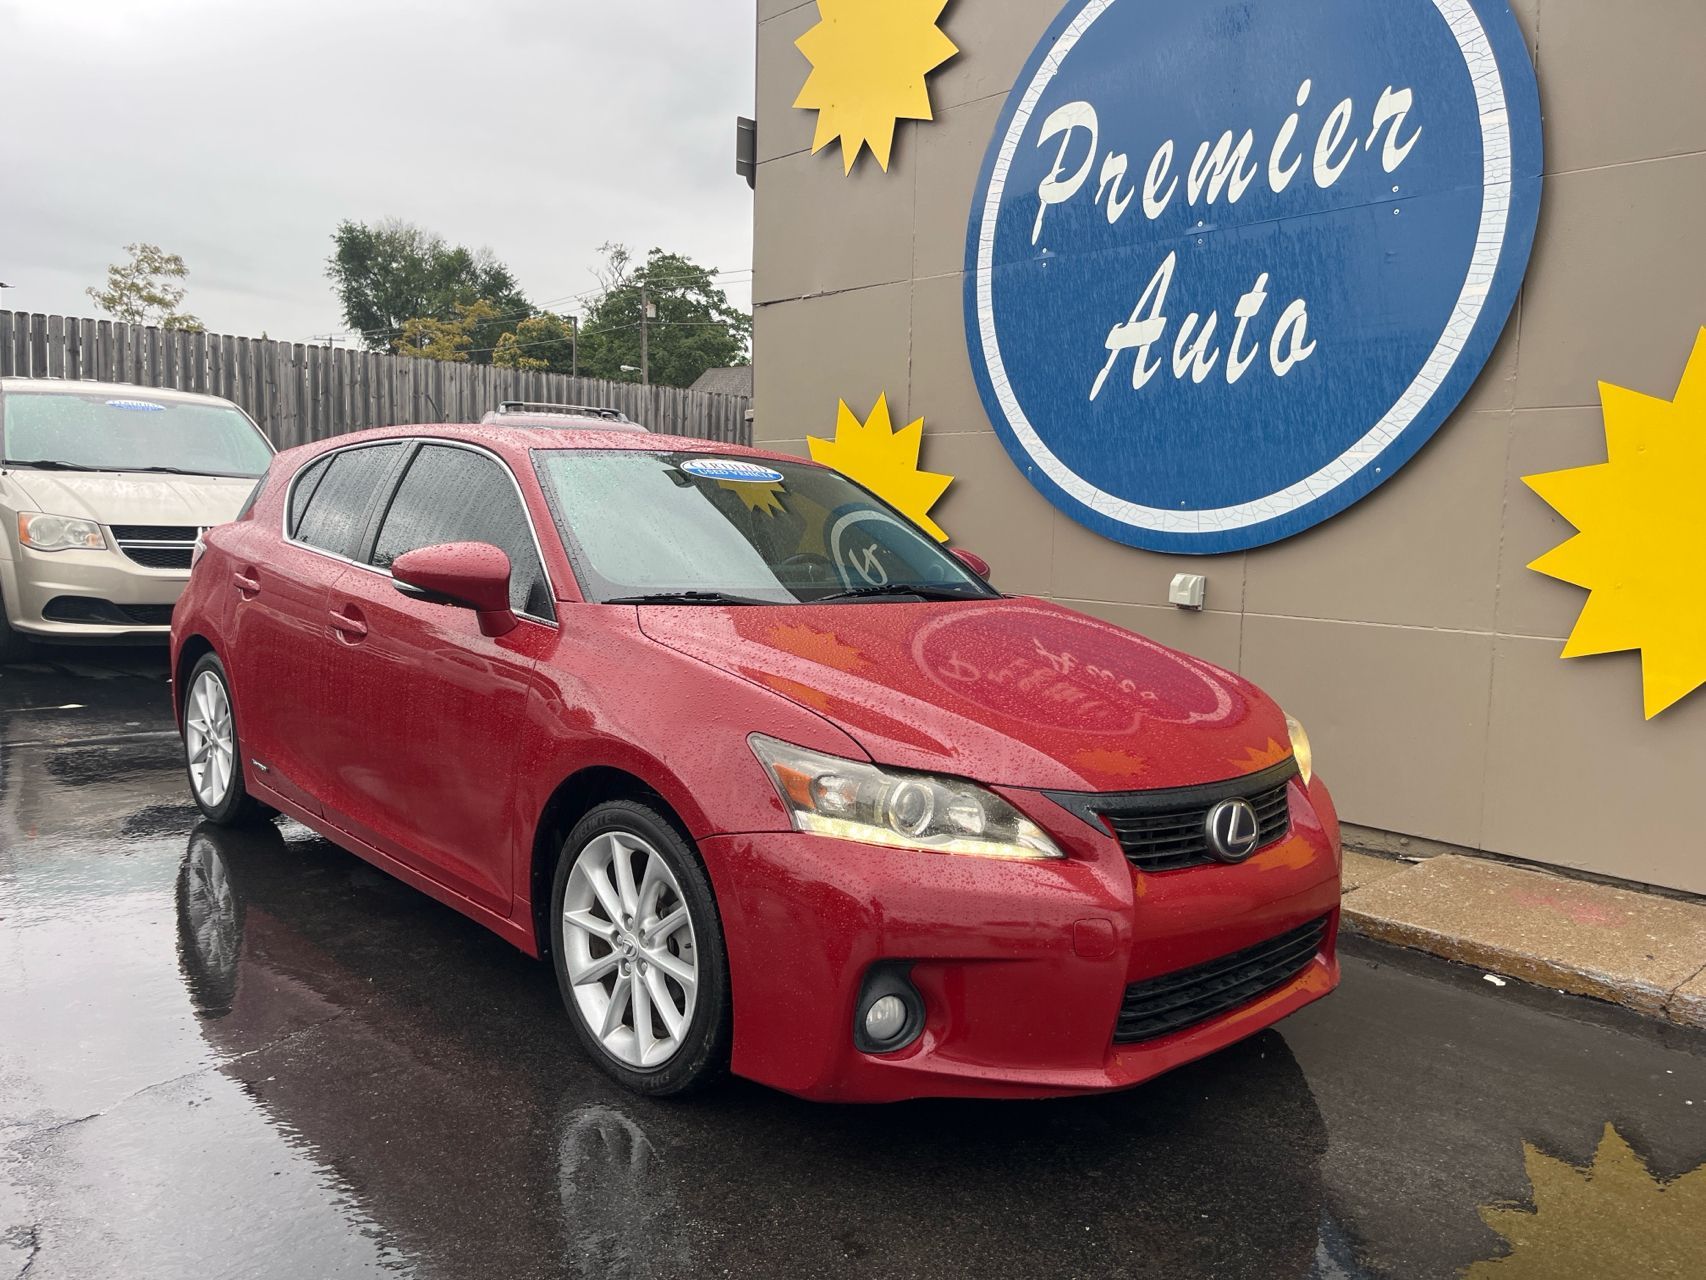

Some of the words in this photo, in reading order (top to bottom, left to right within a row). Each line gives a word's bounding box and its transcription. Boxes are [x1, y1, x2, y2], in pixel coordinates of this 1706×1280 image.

[1032, 79, 1422, 245] Premier
[1089, 251, 1317, 401] Auto
[698, 468, 728, 476] USED
